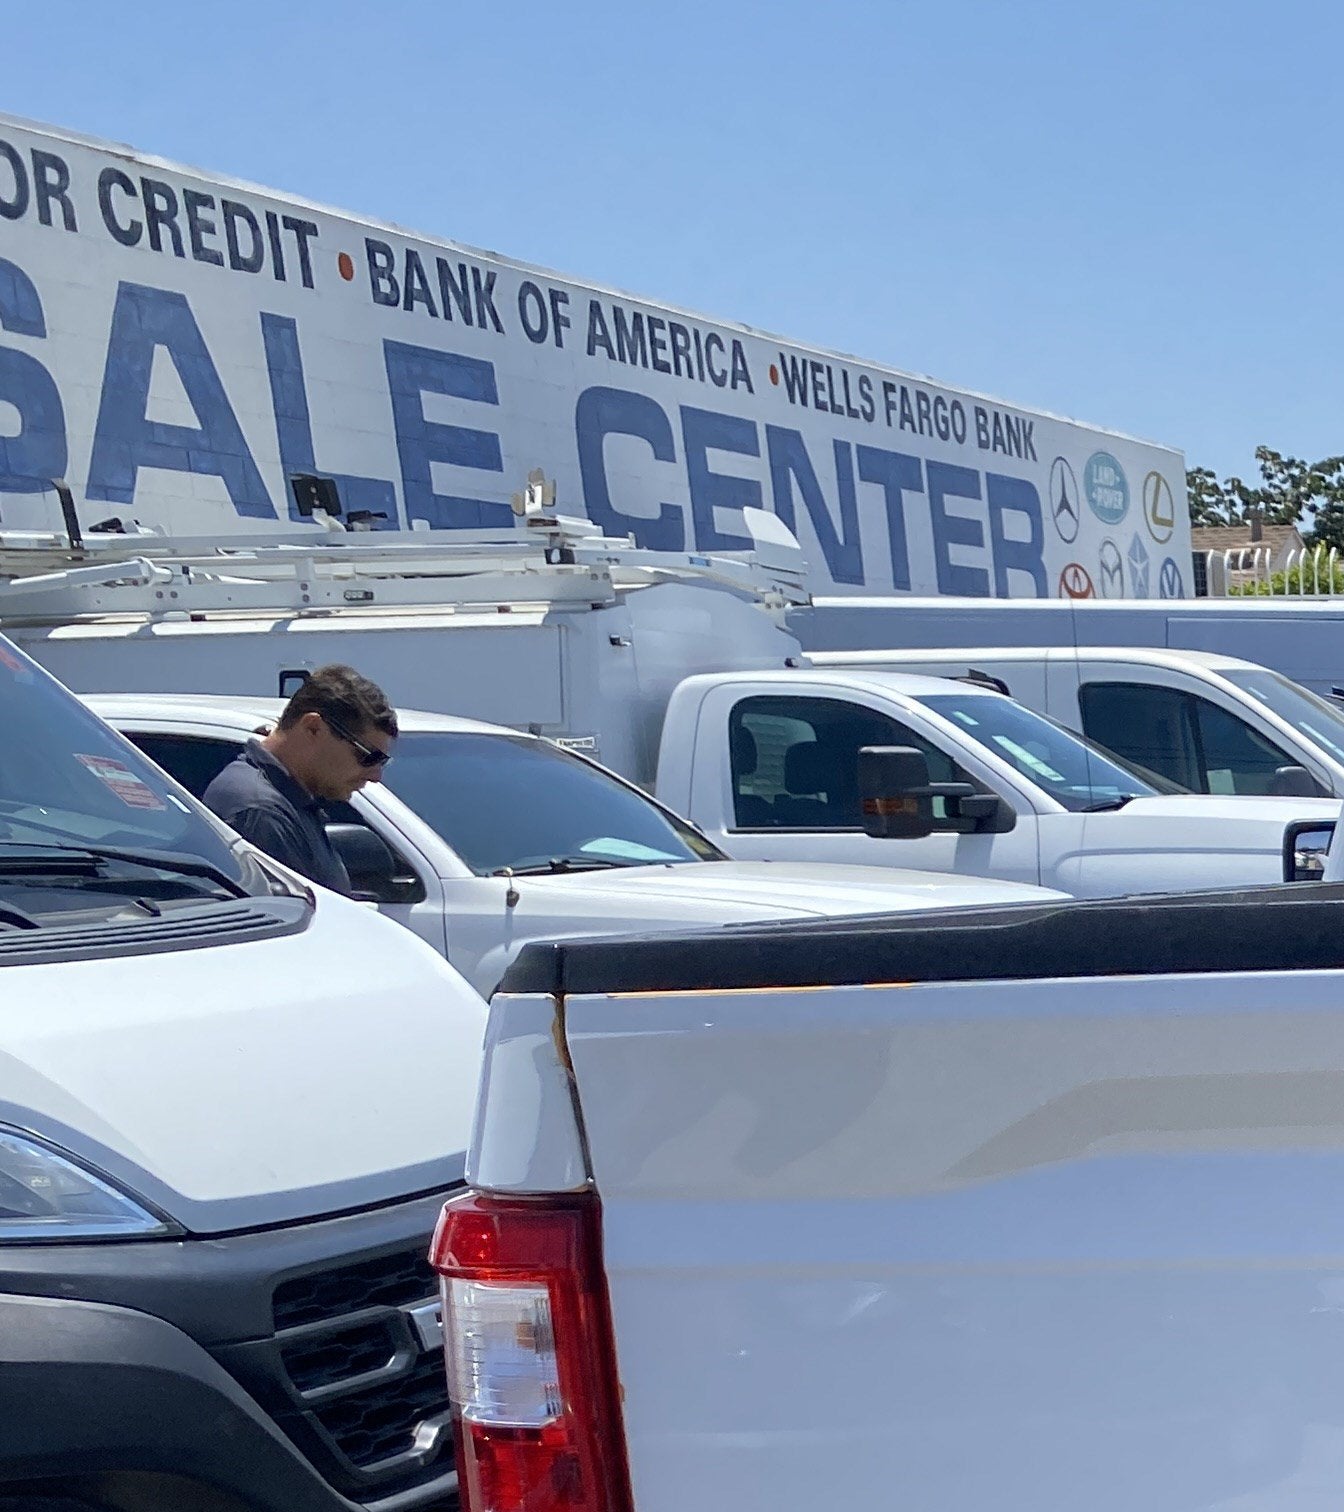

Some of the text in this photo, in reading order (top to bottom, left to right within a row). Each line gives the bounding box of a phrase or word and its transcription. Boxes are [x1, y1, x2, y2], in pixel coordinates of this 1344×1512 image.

[98, 166, 319, 290] CREDIT
[363, 236, 506, 336] BANK
[516, 281, 571, 349] OF
[586, 298, 755, 395] AMERICA
[778, 352, 876, 423] WELLS
[882, 382, 968, 446] FARGO
[975, 406, 1039, 463] BANK
[574, 385, 1048, 600] CENTER
